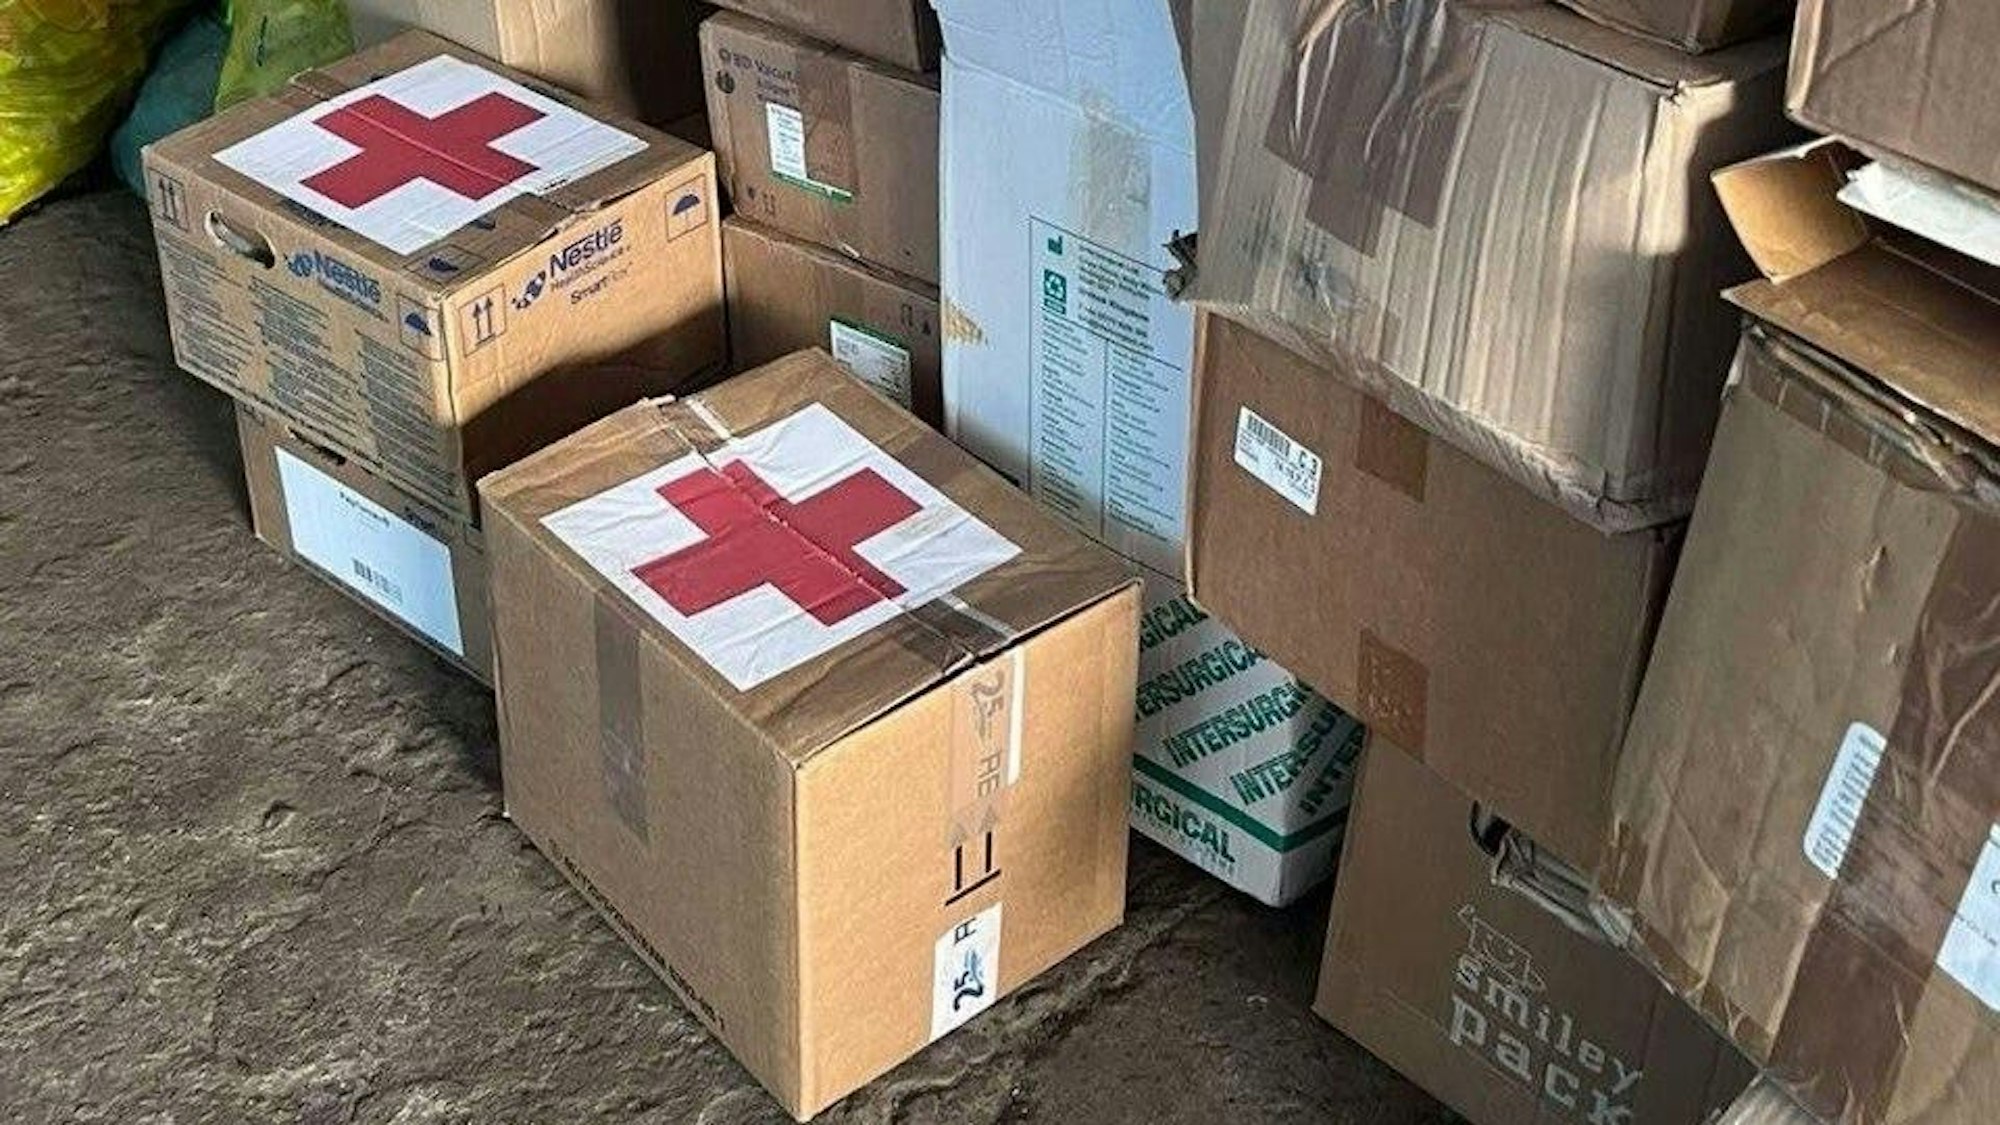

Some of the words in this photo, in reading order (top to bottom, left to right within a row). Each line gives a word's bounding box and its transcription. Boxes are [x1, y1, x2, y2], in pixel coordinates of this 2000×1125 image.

[549, 217, 623, 278] Nestlé
[1139, 594, 1209, 653] GICAL
[1228, 701, 1345, 807] INTERSU
[1448, 993, 1634, 1125] pack
[1454, 952, 1643, 1096] smiley
